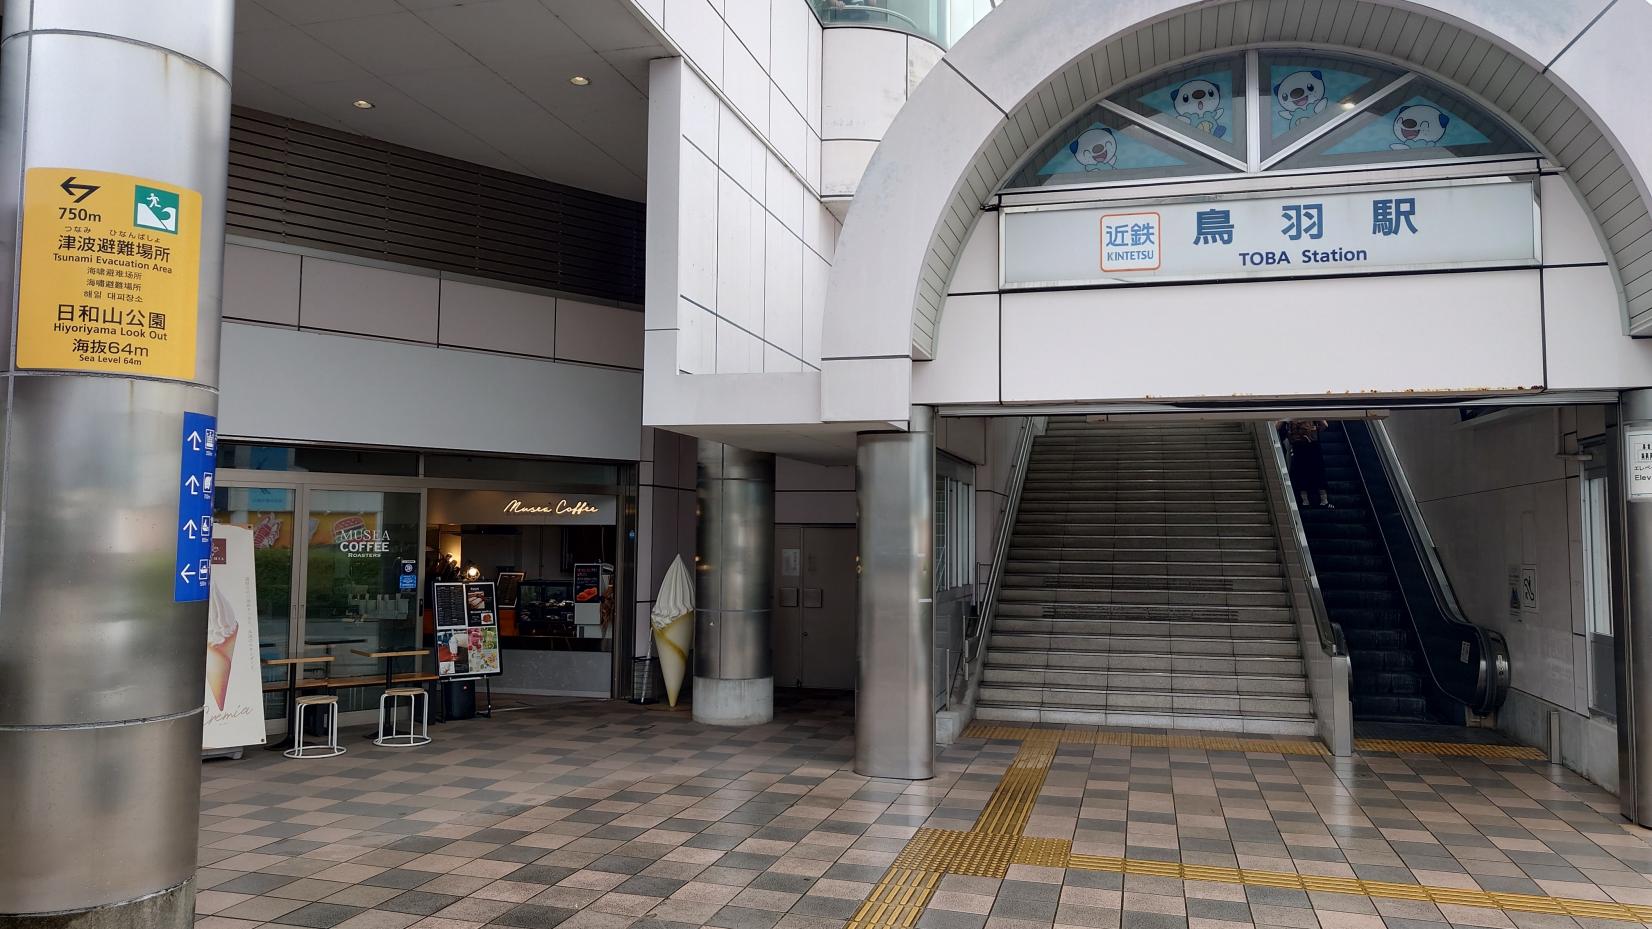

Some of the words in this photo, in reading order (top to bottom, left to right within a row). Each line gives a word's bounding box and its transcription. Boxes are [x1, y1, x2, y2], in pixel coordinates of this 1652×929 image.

[58, 207, 102, 222] 750m
[1193, 197, 1418, 246] 鳥羽駅
[64, 225, 92, 234] つなみ
[1106, 222, 1155, 247] 近鉄
[58, 234, 171, 263] 津波避難場所
[1106, 250, 1154, 262] KINTETSU
[1239, 250, 1291, 267] TOBA
[1301, 247, 1368, 264] Station
[53, 253, 93, 264] Tsunami
[96, 256, 150, 270] Evacuation
[152, 264, 173, 274] Area
[83, 290, 102, 300] 해일
[57, 303, 166, 331] 日和山公園
[54, 322, 117, 336] Hiyoriyama
[120, 327, 146, 339] Look
[149, 330, 168, 341] Out
[72, 338, 149, 358] 海抜64m
[79, 353, 95, 362] Sea
[98, 355, 121, 364] Level
[123, 357, 142, 366] 64m
[503, 499, 552, 513] Musea
[555, 499, 599, 515] Coffee
[340, 529, 391, 541] MUSEA
[340, 541, 390, 552] COFFEE
